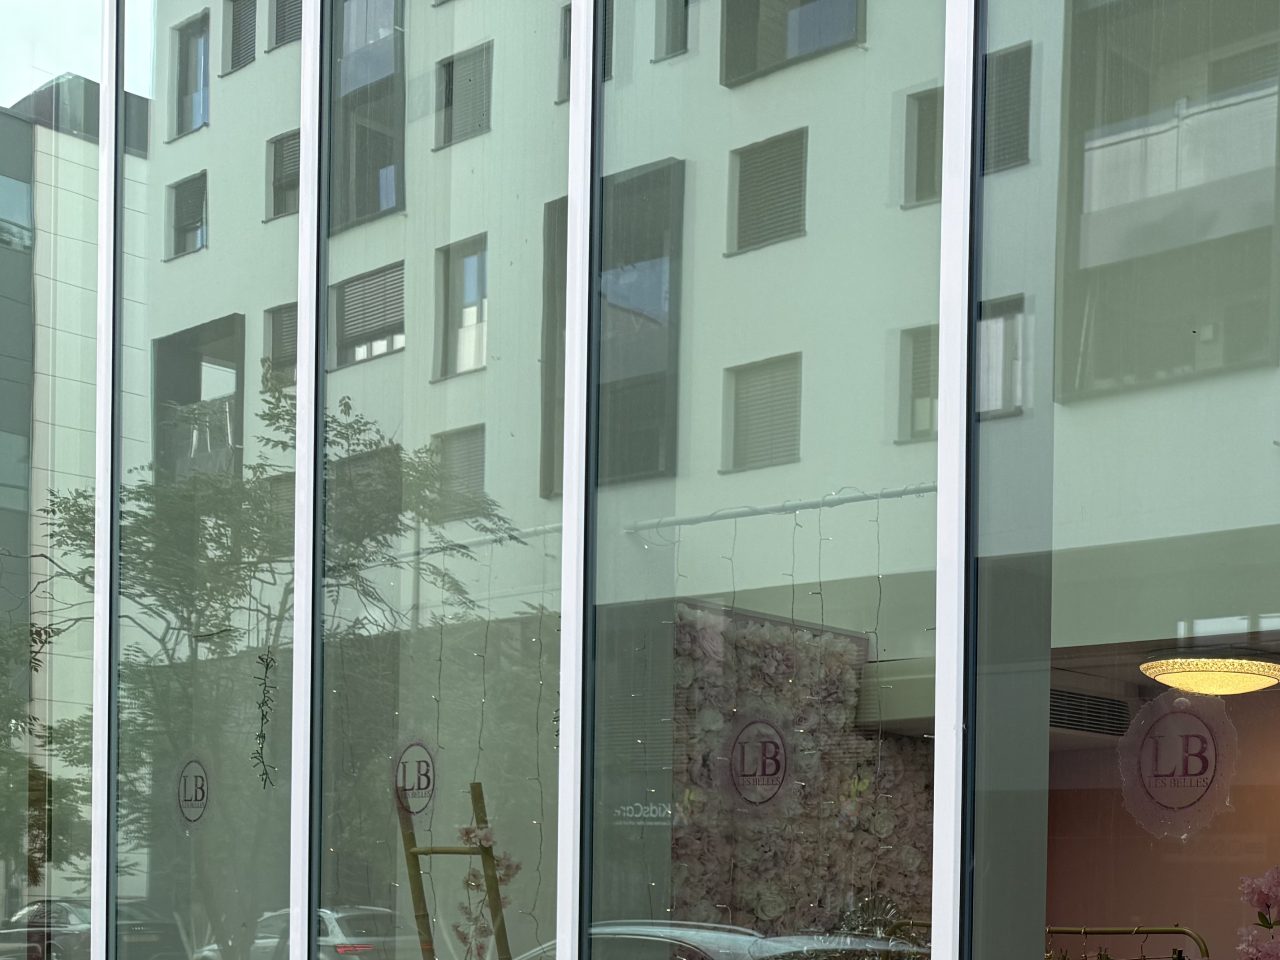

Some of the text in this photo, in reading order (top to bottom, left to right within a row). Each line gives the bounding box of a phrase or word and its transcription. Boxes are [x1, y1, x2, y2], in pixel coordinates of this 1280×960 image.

[737, 741, 781, 777] LB
[1147, 734, 1209, 778] LB
[182, 775, 205, 802] LB
[400, 760, 431, 791] LB
[1169, 777, 1209, 788] BELLES
